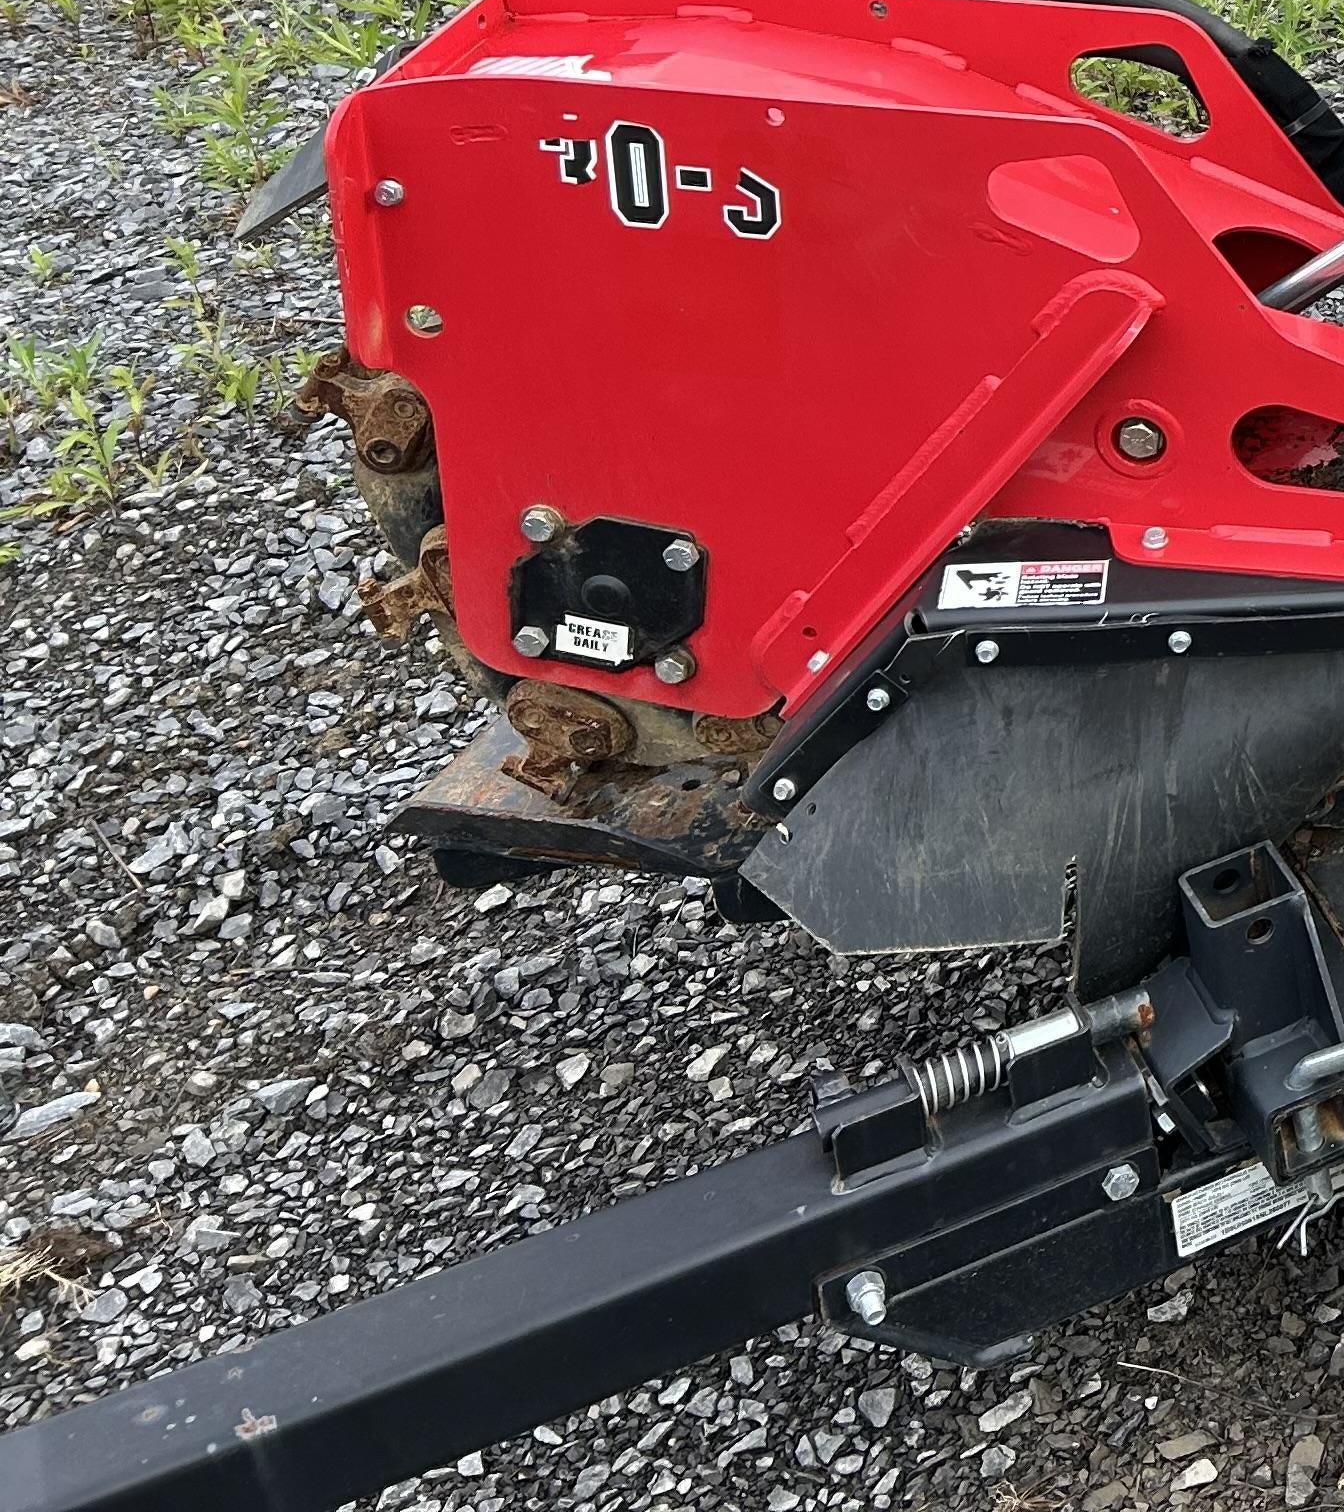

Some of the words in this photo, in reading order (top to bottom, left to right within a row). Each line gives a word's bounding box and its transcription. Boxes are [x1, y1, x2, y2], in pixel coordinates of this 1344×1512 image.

[1040, 564, 1102, 573] DANGER
[568, 622, 619, 643] GREASE
[573, 635, 609, 652] DAILY
